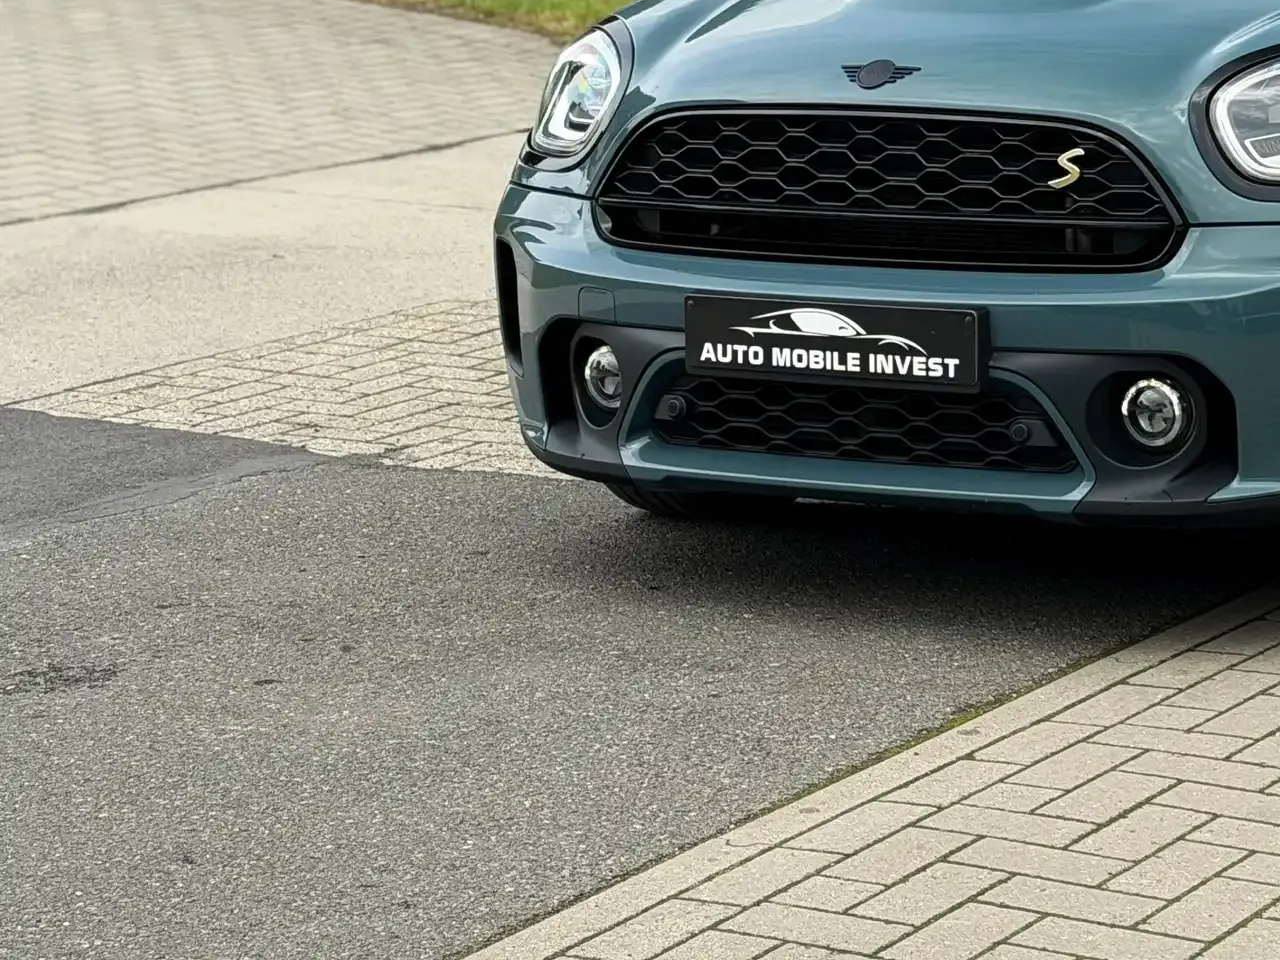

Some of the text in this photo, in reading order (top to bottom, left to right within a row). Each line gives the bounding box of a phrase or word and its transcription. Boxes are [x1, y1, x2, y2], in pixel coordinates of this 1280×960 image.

[1047, 147, 1085, 189] S
[699, 342, 960, 379] AUTO MOBILE INVEST
